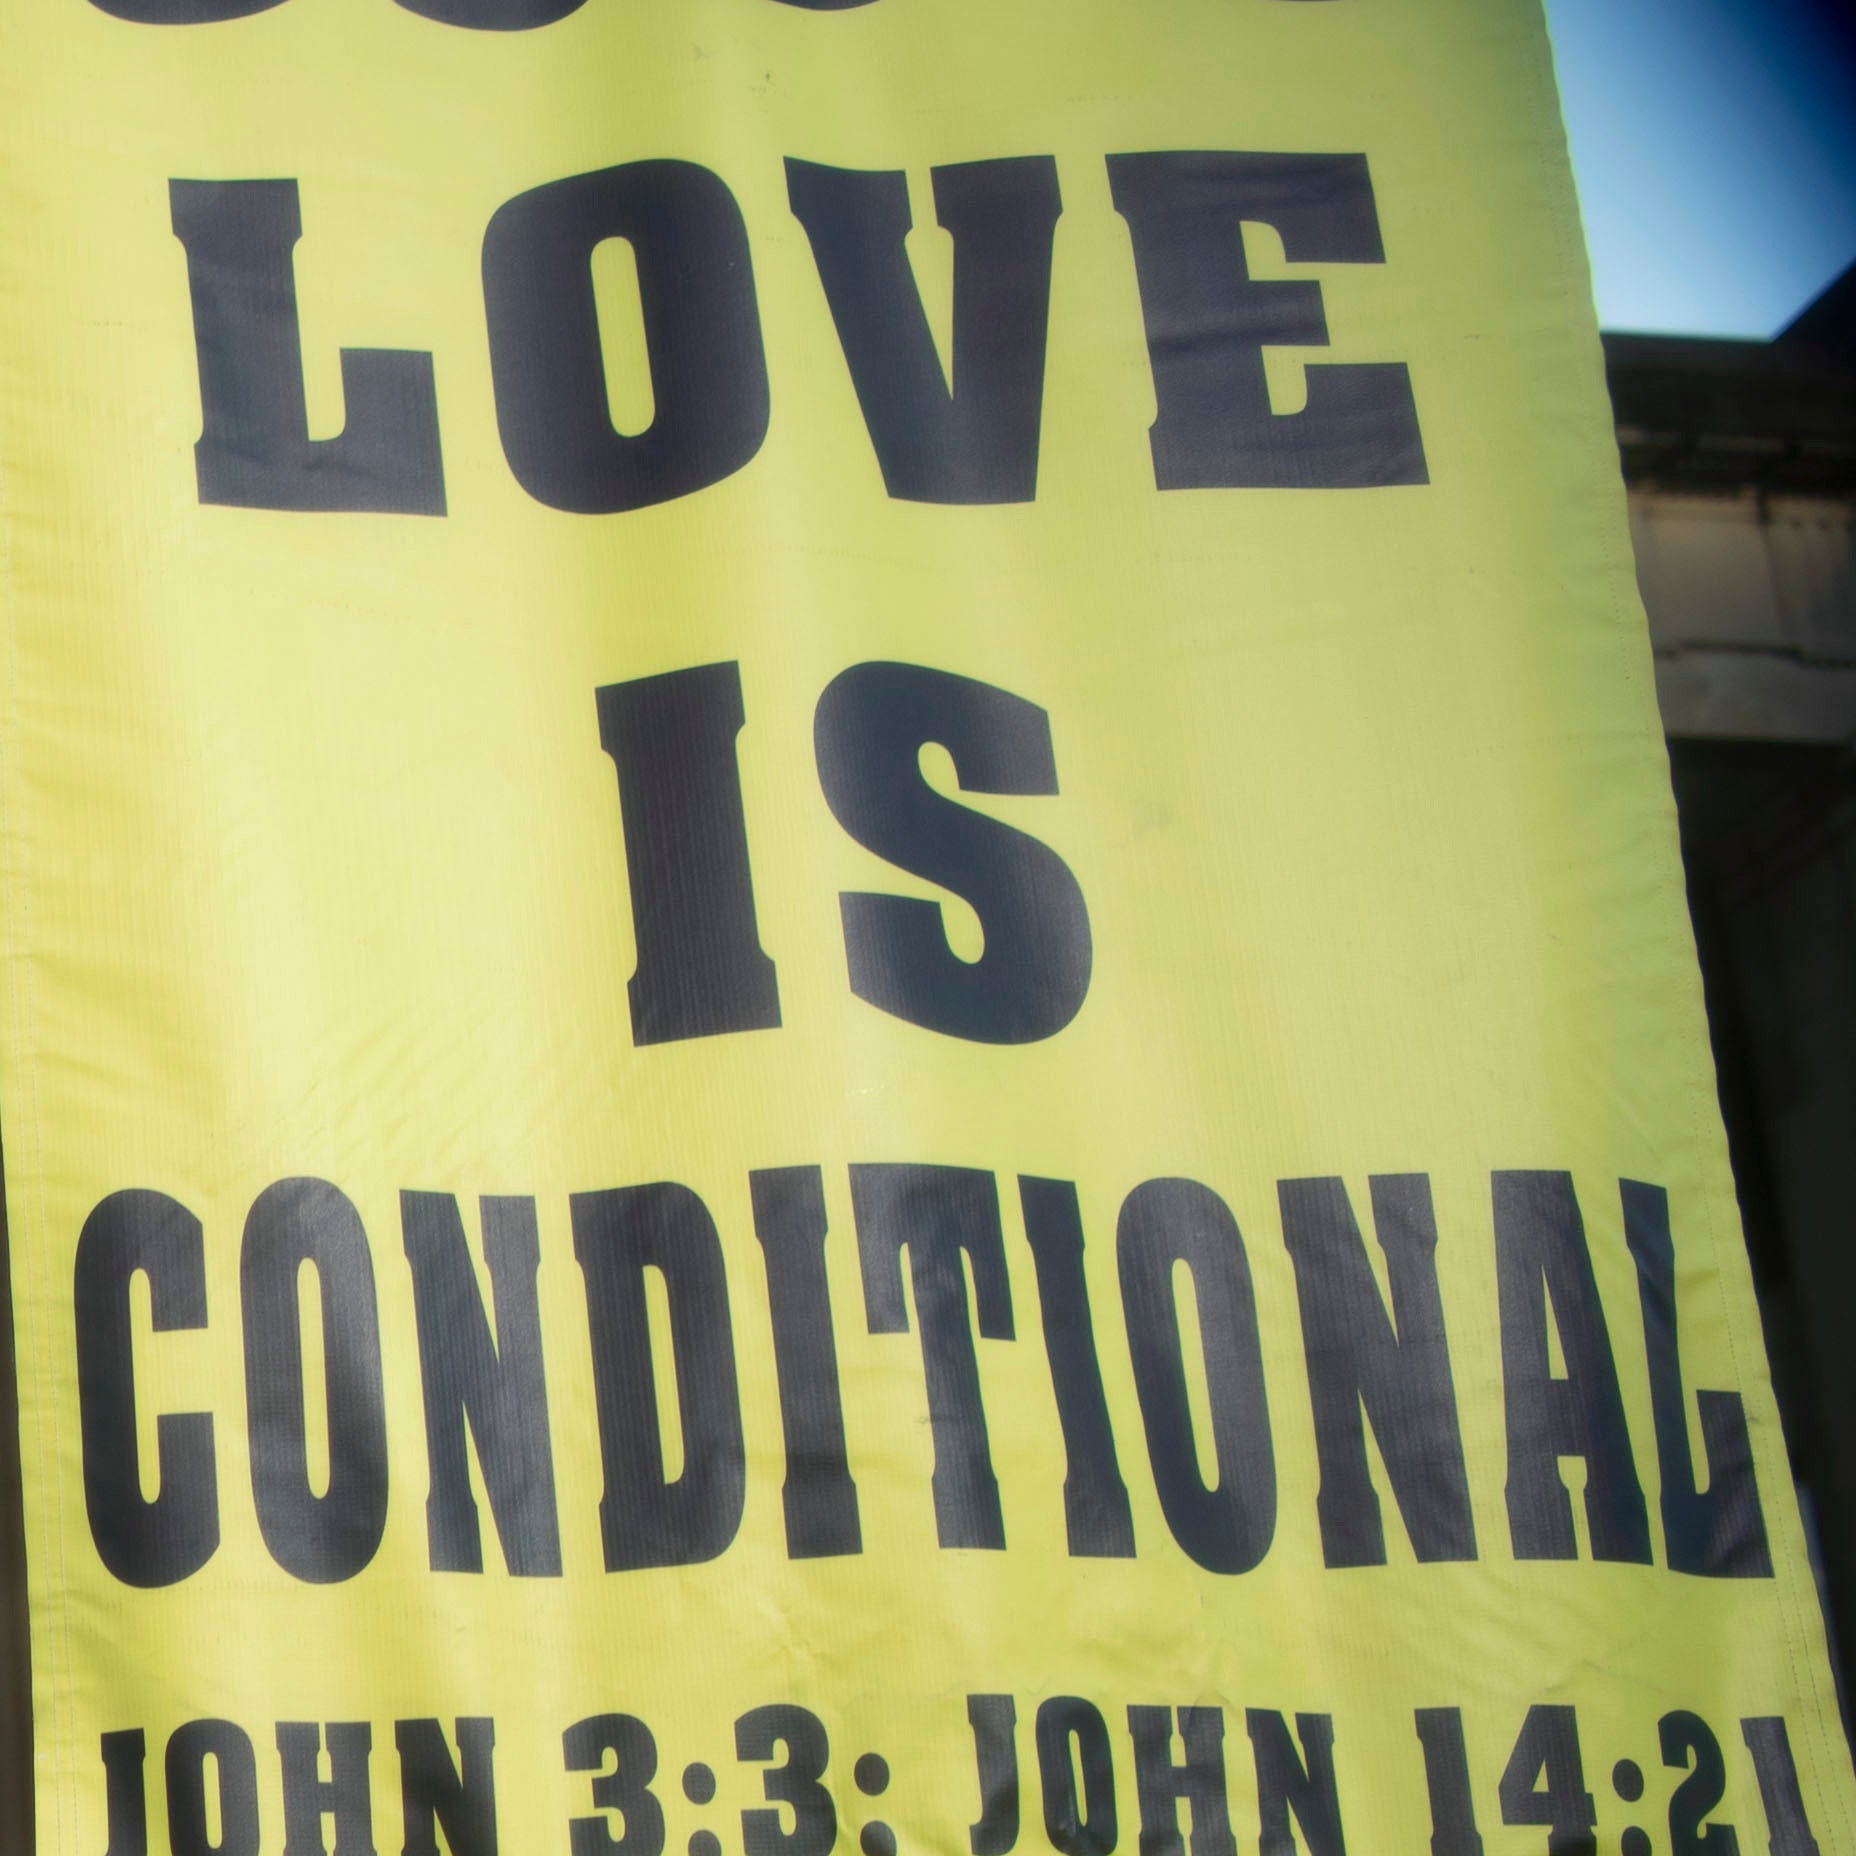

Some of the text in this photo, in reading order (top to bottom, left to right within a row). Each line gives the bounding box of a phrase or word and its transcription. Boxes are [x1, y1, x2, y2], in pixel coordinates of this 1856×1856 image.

[169, 149, 1430, 516] LOVE
[595, 660, 1092, 1047] IS
[73, 1162, 1776, 1589] CONDITIONAL
